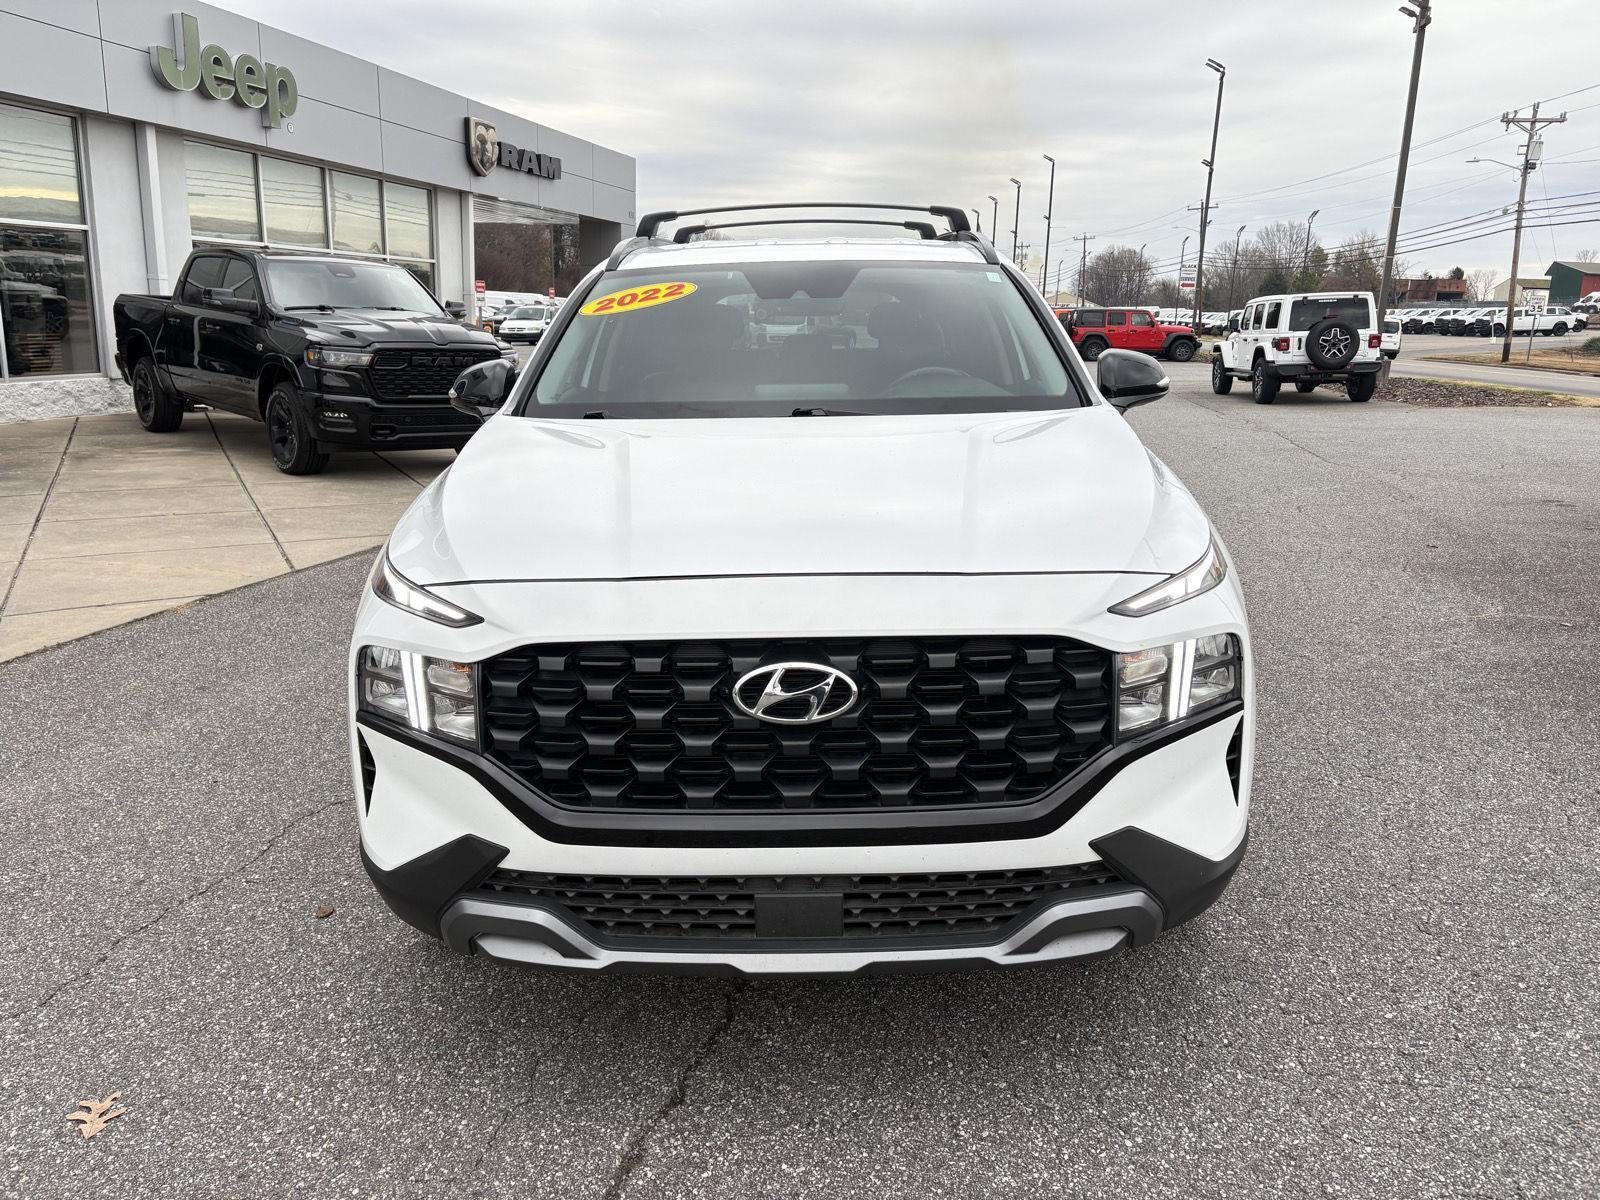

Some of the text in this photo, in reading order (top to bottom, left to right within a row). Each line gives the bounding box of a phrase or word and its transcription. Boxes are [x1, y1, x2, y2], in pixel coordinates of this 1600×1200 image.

[149, 12, 298, 129] Jeep
[497, 141, 561, 180] RAM
[592, 284, 685, 313] 2022
[1530, 304, 1543, 313] 35
[411, 356, 475, 367] RAM
